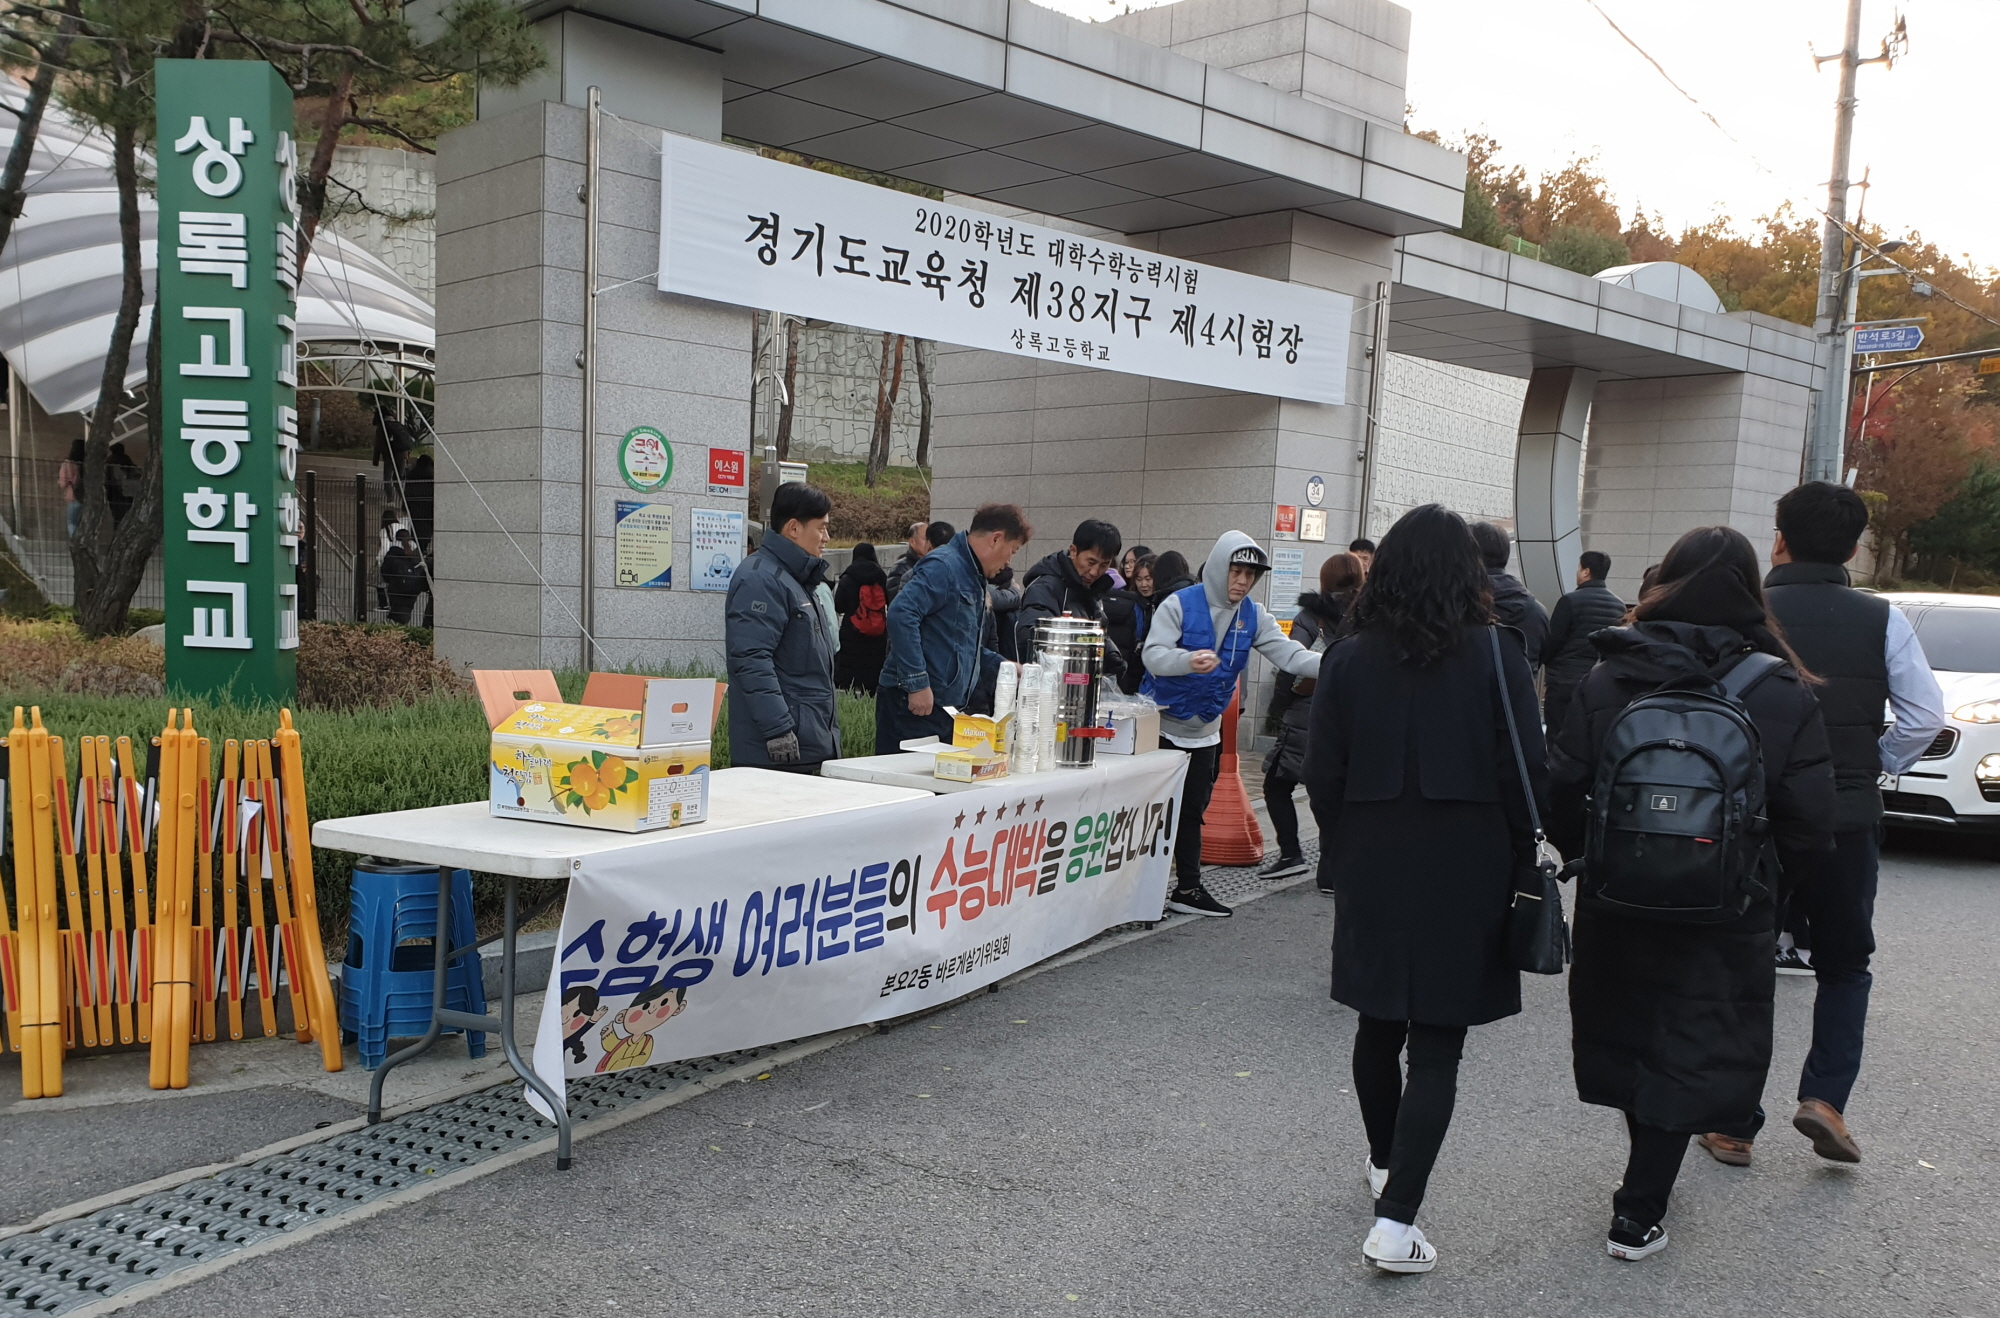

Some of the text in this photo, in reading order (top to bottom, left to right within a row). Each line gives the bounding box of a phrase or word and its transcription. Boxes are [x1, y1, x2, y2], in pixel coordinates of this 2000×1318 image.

[914, 208, 1199, 296] 2020학년도 대학수학능력시험
[744, 211, 1304, 365] 경기도교육청 제38지구 제4시험장
[1010, 328, 1111, 361] 상록고등학교
[1857, 330, 1906, 344] 반석로3길
[174, 116, 258, 650] 상록고등학교
[714, 459, 739, 474] 에스원
[708, 486, 729, 494] SECOM
[1311, 486, 1320, 496] 34
[962, 727, 987, 738] Maxim
[561, 797, 1174, 997] 수험생 여러분들의 수능대박을 응원합니다!
[880, 933, 1012, 998] 본오2동 바르게살기위원회
